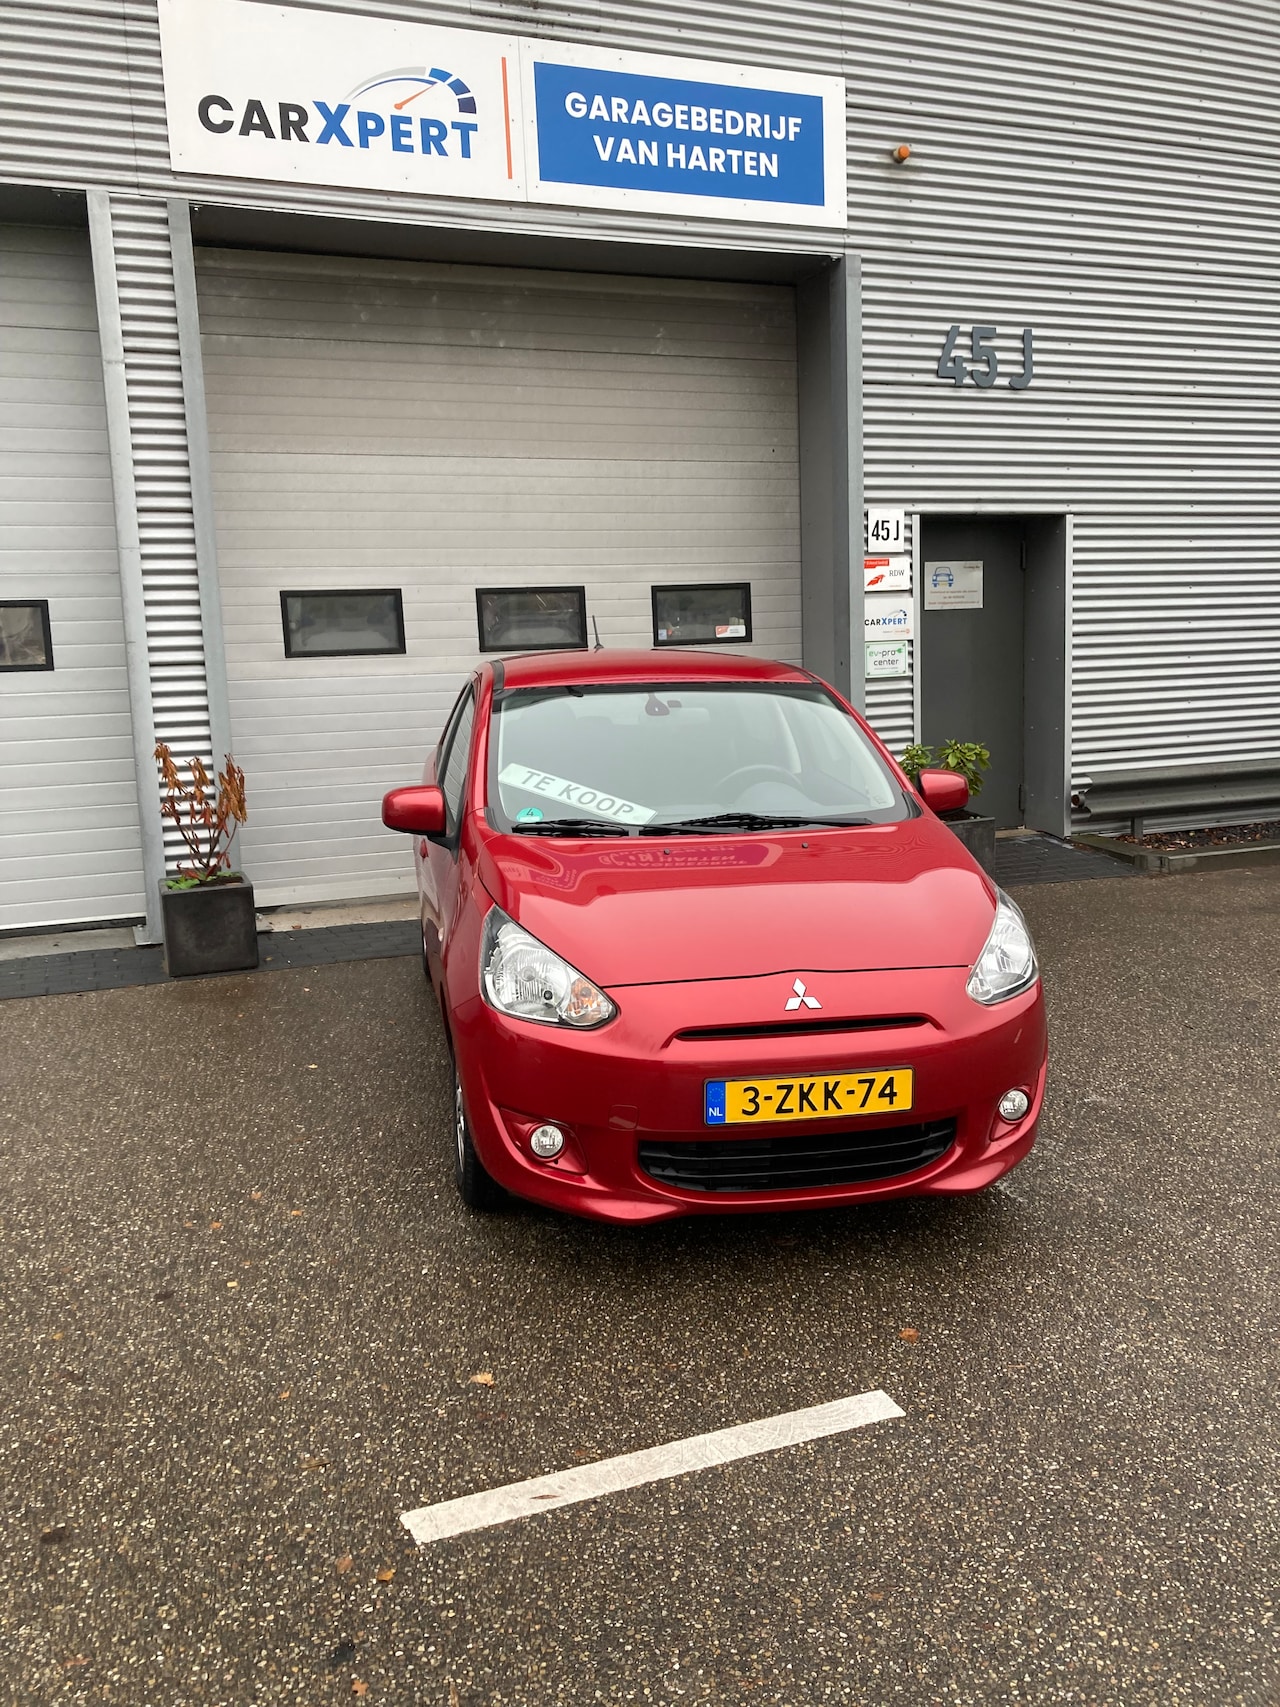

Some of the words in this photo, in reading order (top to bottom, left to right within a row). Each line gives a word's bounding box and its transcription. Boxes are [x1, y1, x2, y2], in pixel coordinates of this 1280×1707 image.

[197, 94, 478, 159] CARXPERT
[564, 91, 802, 141] GARAGEBEDRIJF
[592, 134, 659, 167] VAN
[666, 142, 778, 178] HARTEN
[937, 325, 998, 388] 45
[1009, 328, 1033, 390] J
[871, 519, 890, 541] 45
[893, 519, 900, 541] J
[889, 569, 905, 577] RDW
[864, 617, 907, 626] CARXPERT
[868, 649, 896, 658] ev-pro
[521, 770, 556, 792] TE
[557, 783, 635, 816] KOOP
[526, 808, 534, 816] 4
[708, 1106, 723, 1117] NL
[741, 1076, 898, 1117] 3-ZKK-74
